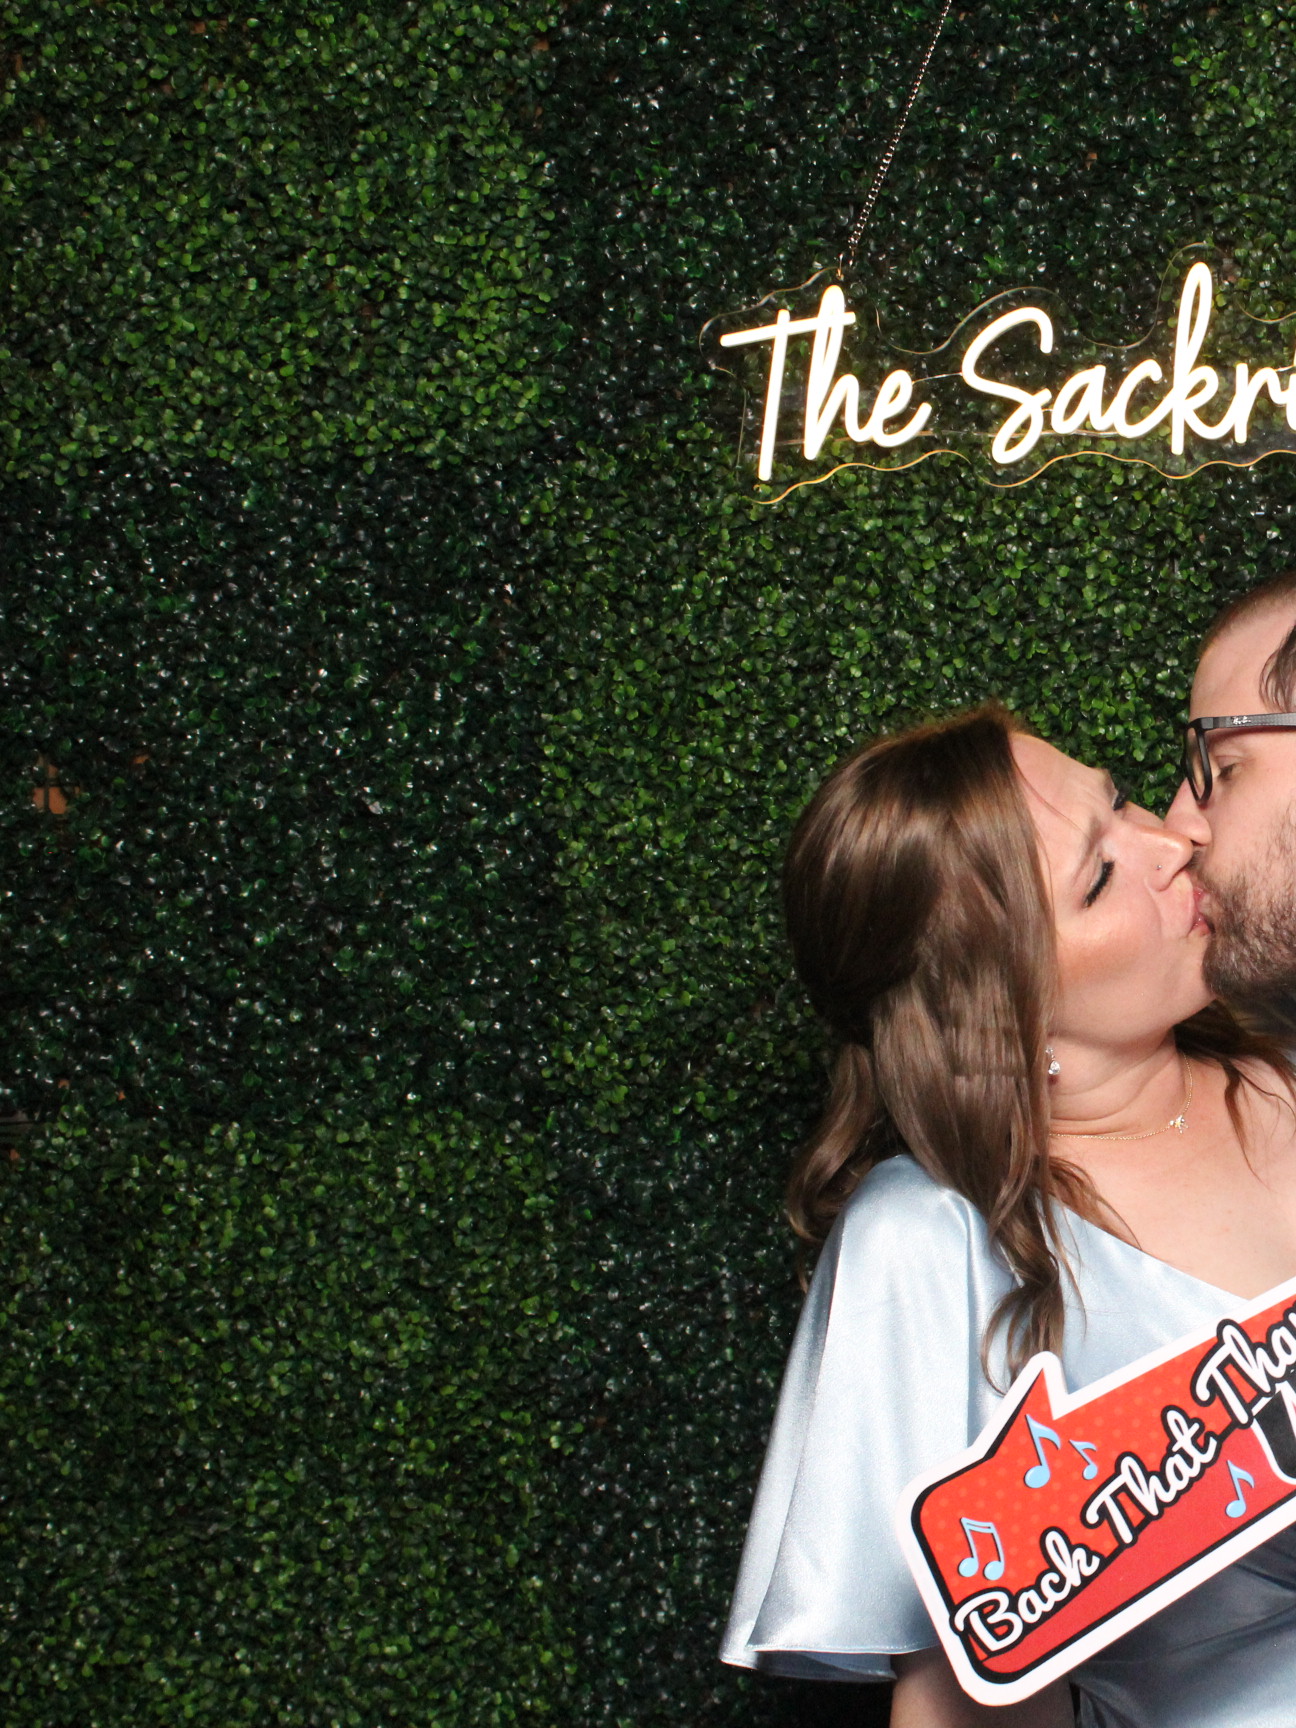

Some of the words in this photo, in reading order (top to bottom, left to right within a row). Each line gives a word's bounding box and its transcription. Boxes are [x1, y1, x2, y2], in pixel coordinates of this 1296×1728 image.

[719, 285, 932, 481] The
[954, 1529, 1100, 1653] Back
[1086, 1404, 1218, 1544] That
